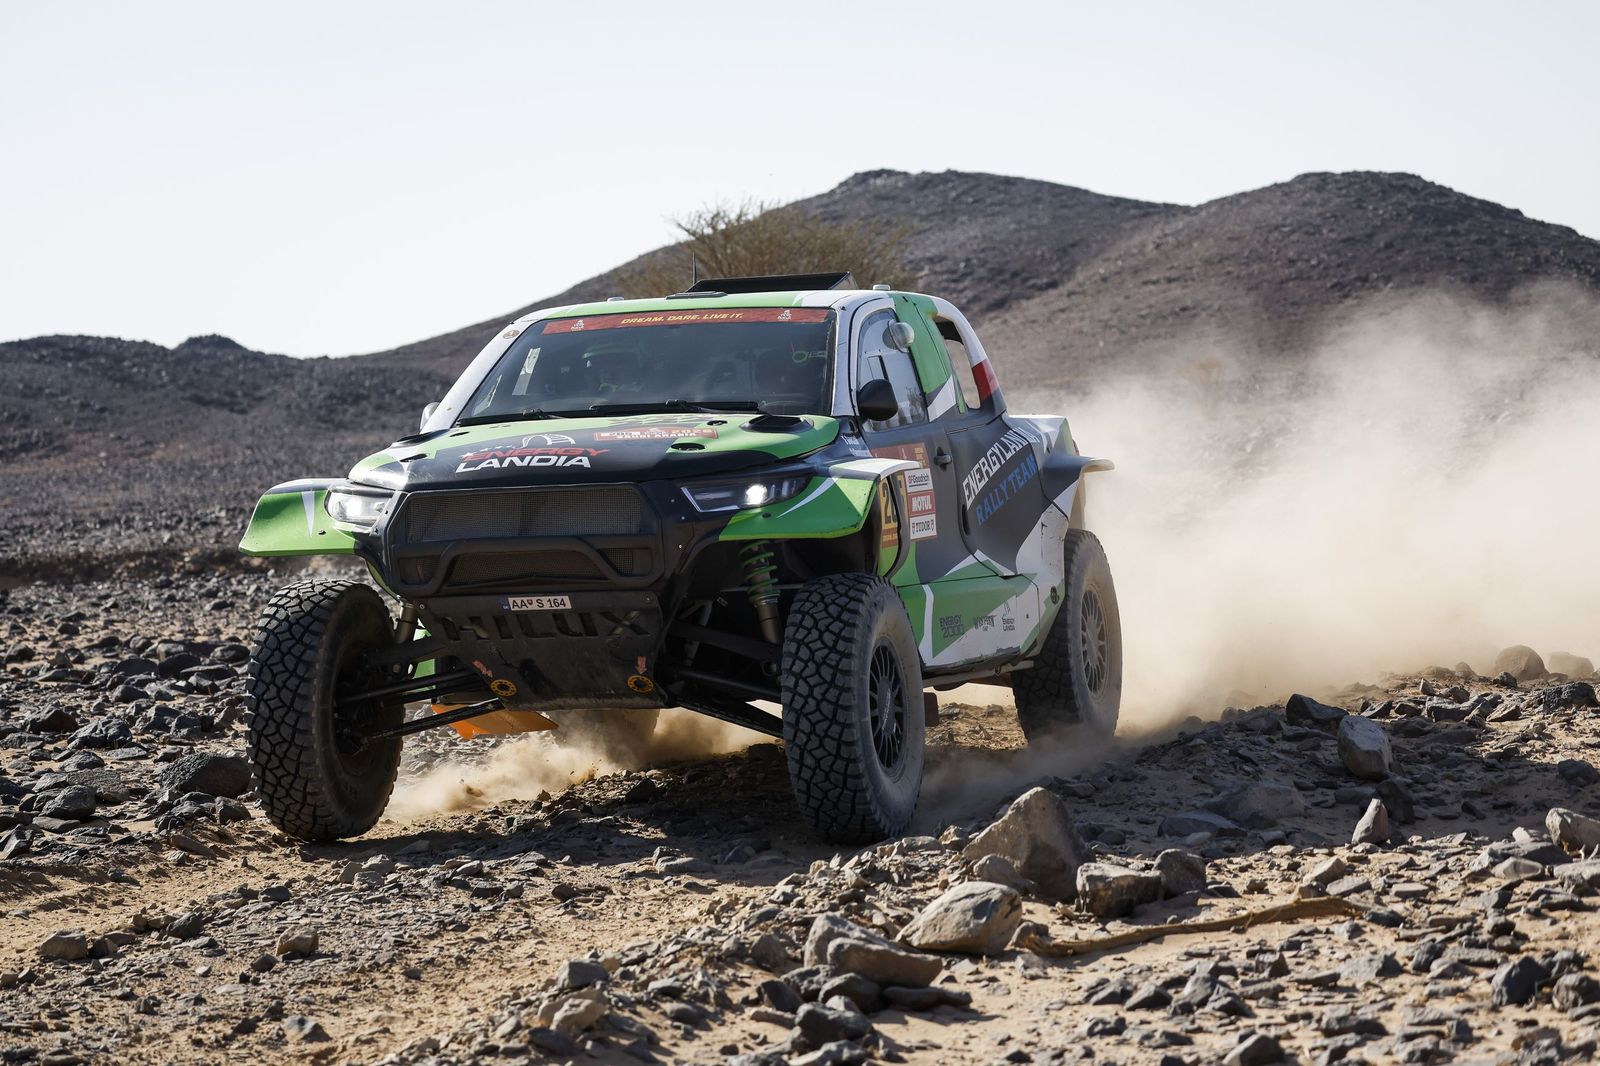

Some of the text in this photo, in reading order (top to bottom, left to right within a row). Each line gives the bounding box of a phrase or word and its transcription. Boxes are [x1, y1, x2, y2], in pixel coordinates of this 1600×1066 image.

[621, 316, 664, 324] DREAM.
[463, 447, 610, 462] ENERGY
[455, 455, 591, 474] LANDIA
[908, 473, 930, 484] BFGoodrich
[975, 453, 1038, 526] RALLY TEAM
[912, 494, 932, 512] MOTUL
[512, 598, 528, 609] AA
[536, 599, 544, 609] S
[547, 597, 567, 608] 164
[441, 610, 651, 642] HILUX
[939, 614, 962, 628] ENERGY
